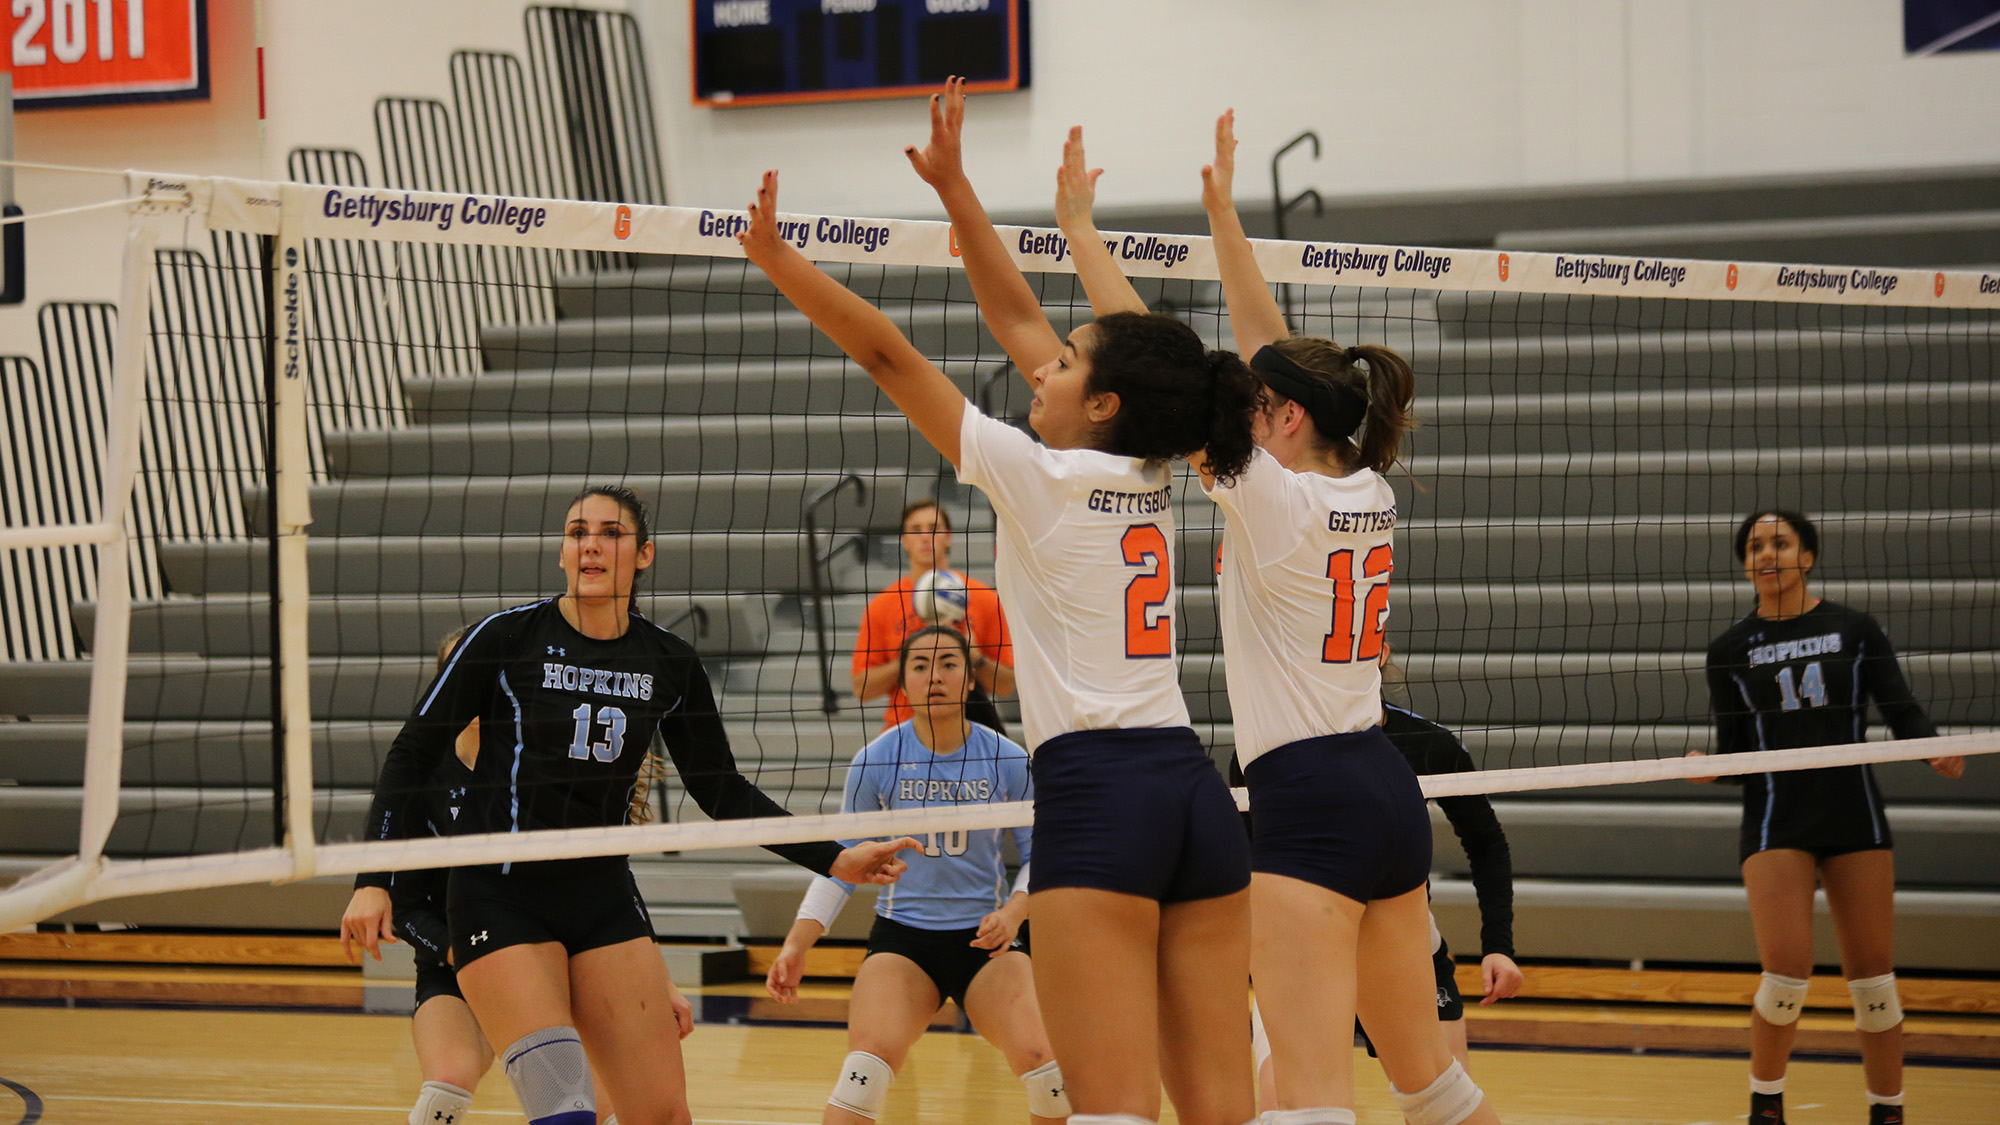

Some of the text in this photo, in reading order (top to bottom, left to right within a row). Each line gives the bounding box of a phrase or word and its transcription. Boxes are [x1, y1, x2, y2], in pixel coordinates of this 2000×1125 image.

[713, 0, 771, 27] HOME
[12, 0, 144, 66] 2011
[323, 189, 546, 234] Gettysburg College
[614, 205, 631, 240] G
[699, 210, 889, 252] Getturg College
[1121, 235, 1189, 267] College
[1301, 244, 1451, 278] Gettysburg College
[1498, 253, 1510, 282] G
[1555, 256, 1686, 288] Gettysburg College
[1777, 266, 1898, 295] Gettysburg College
[284, 273, 299, 380] Schelde
[1121, 523, 1172, 660] 2
[1321, 542, 1394, 664] 12
[1747, 632, 1842, 666] HOPKINS
[542, 663, 654, 701] HOPKINS
[1775, 661, 1828, 712] 14
[568, 703, 627, 763] 13
[900, 778, 990, 801] HOPKINS
